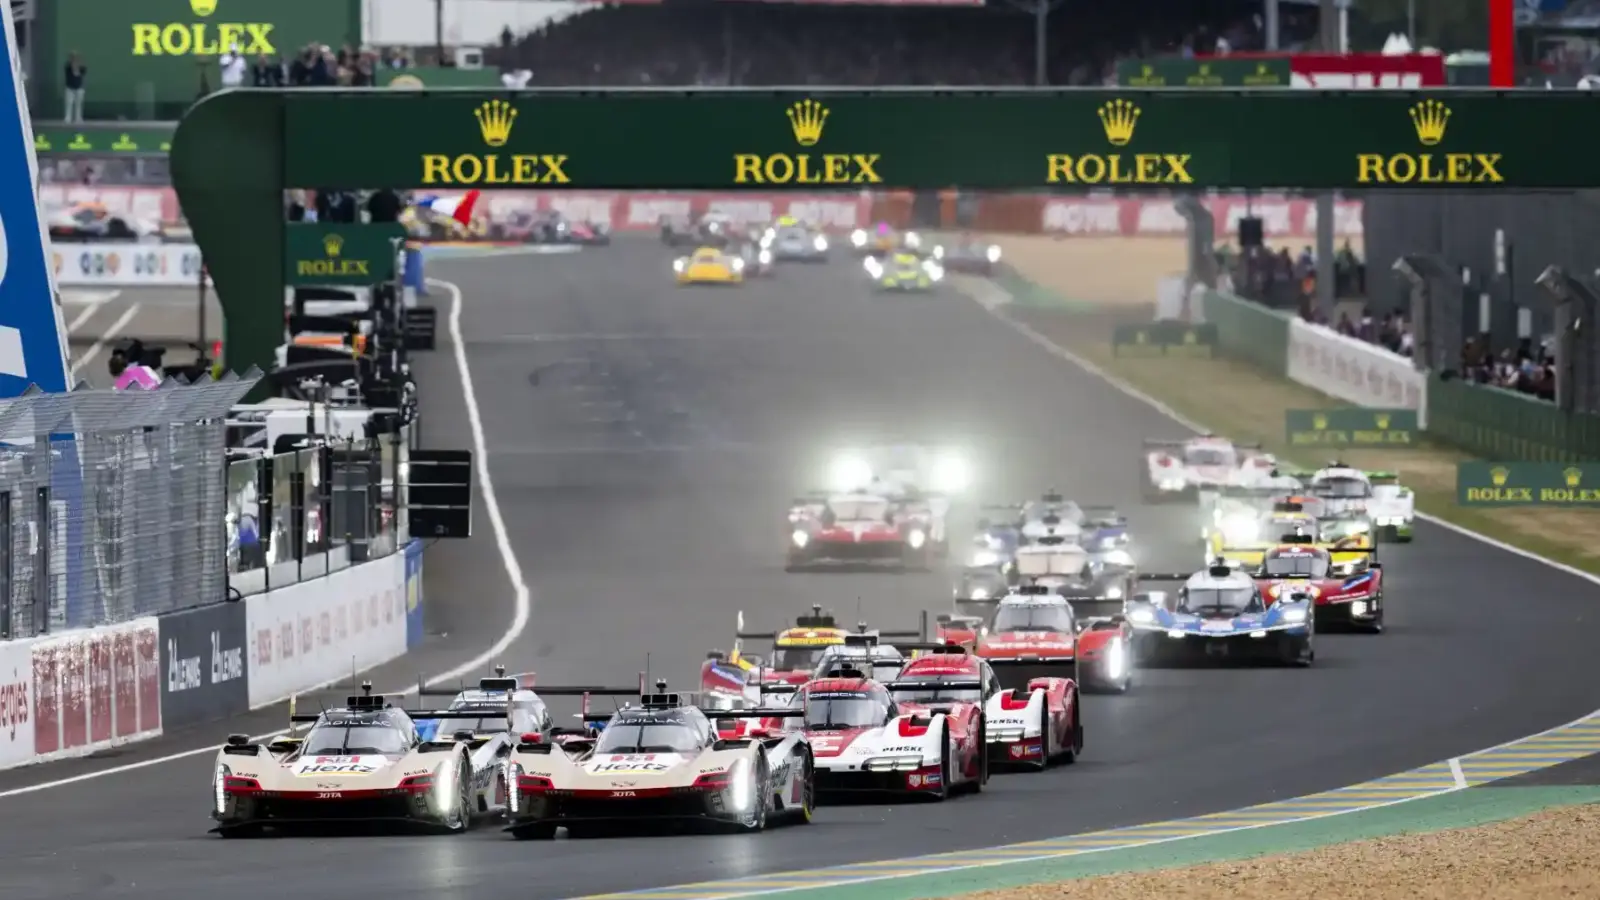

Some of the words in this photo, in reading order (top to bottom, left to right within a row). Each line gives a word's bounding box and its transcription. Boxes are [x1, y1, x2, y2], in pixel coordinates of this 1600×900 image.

[132, 23, 275, 55] ROLEX
[423, 153, 569, 184] ROLEX
[735, 153, 881, 184] ROLEX
[1047, 153, 1193, 184] ROLEX
[1358, 153, 1504, 184] ROLEX
[297, 259, 369, 276] ROLEX
[1466, 487, 1533, 502] ROLEX
[300, 764, 377, 774] Hertz
[593, 762, 670, 772] Hertz
